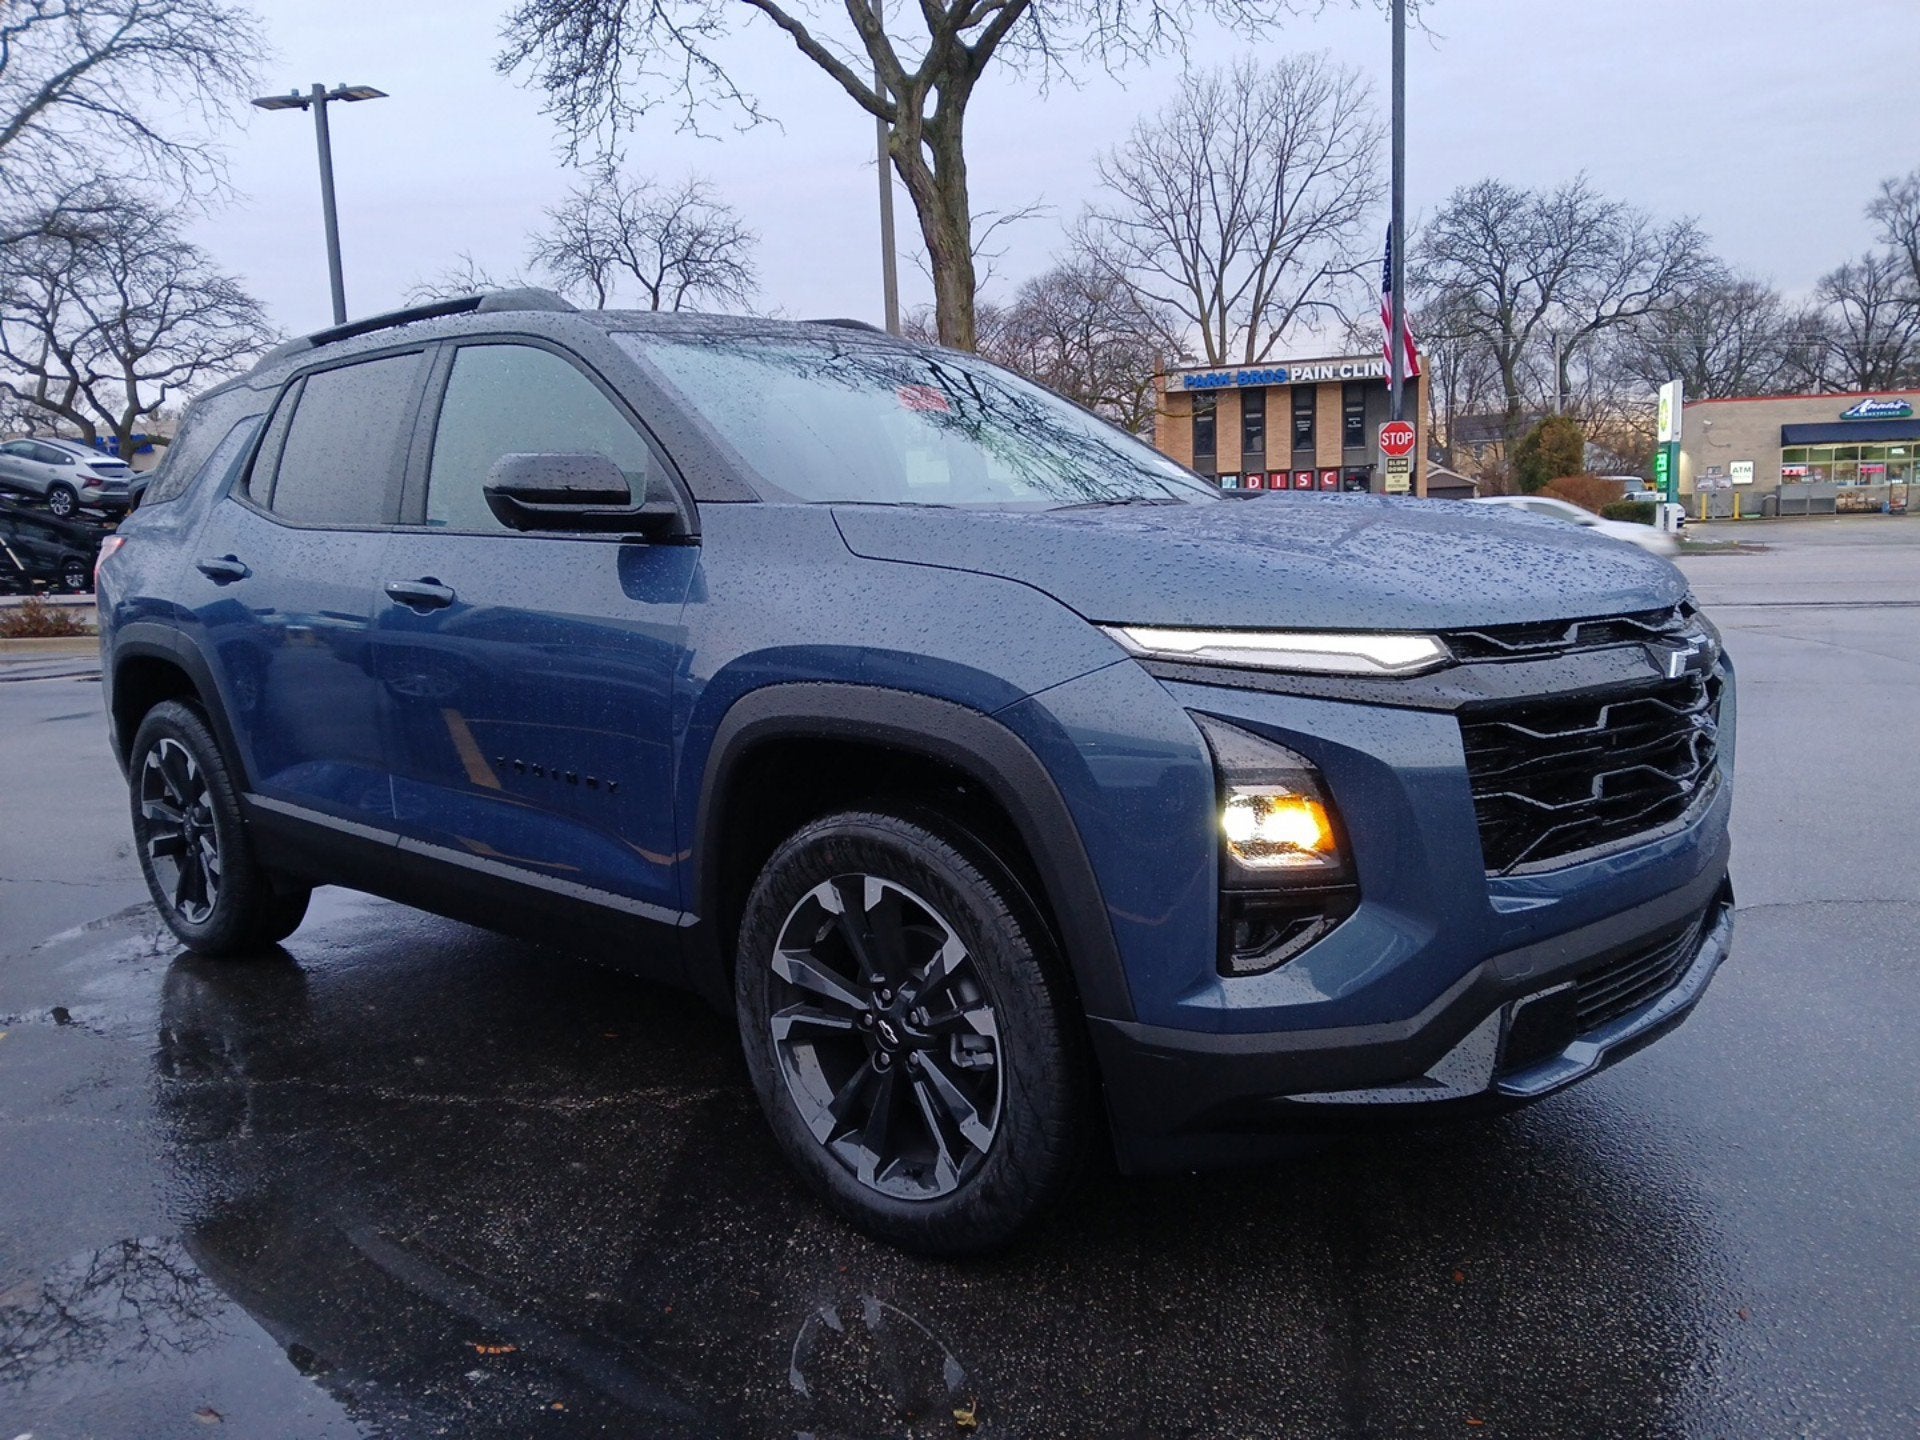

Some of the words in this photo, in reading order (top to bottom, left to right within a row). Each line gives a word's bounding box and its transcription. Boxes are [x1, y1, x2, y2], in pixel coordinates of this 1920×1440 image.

[1184, 373, 1231, 389] PARK
[1237, 368, 1287, 386] BROS
[1291, 366, 1333, 381] PAIN
[1339, 362, 1384, 379] CLIN
[1381, 431, 1413, 446] STOP
[1248, 472, 1334, 489] DISC
